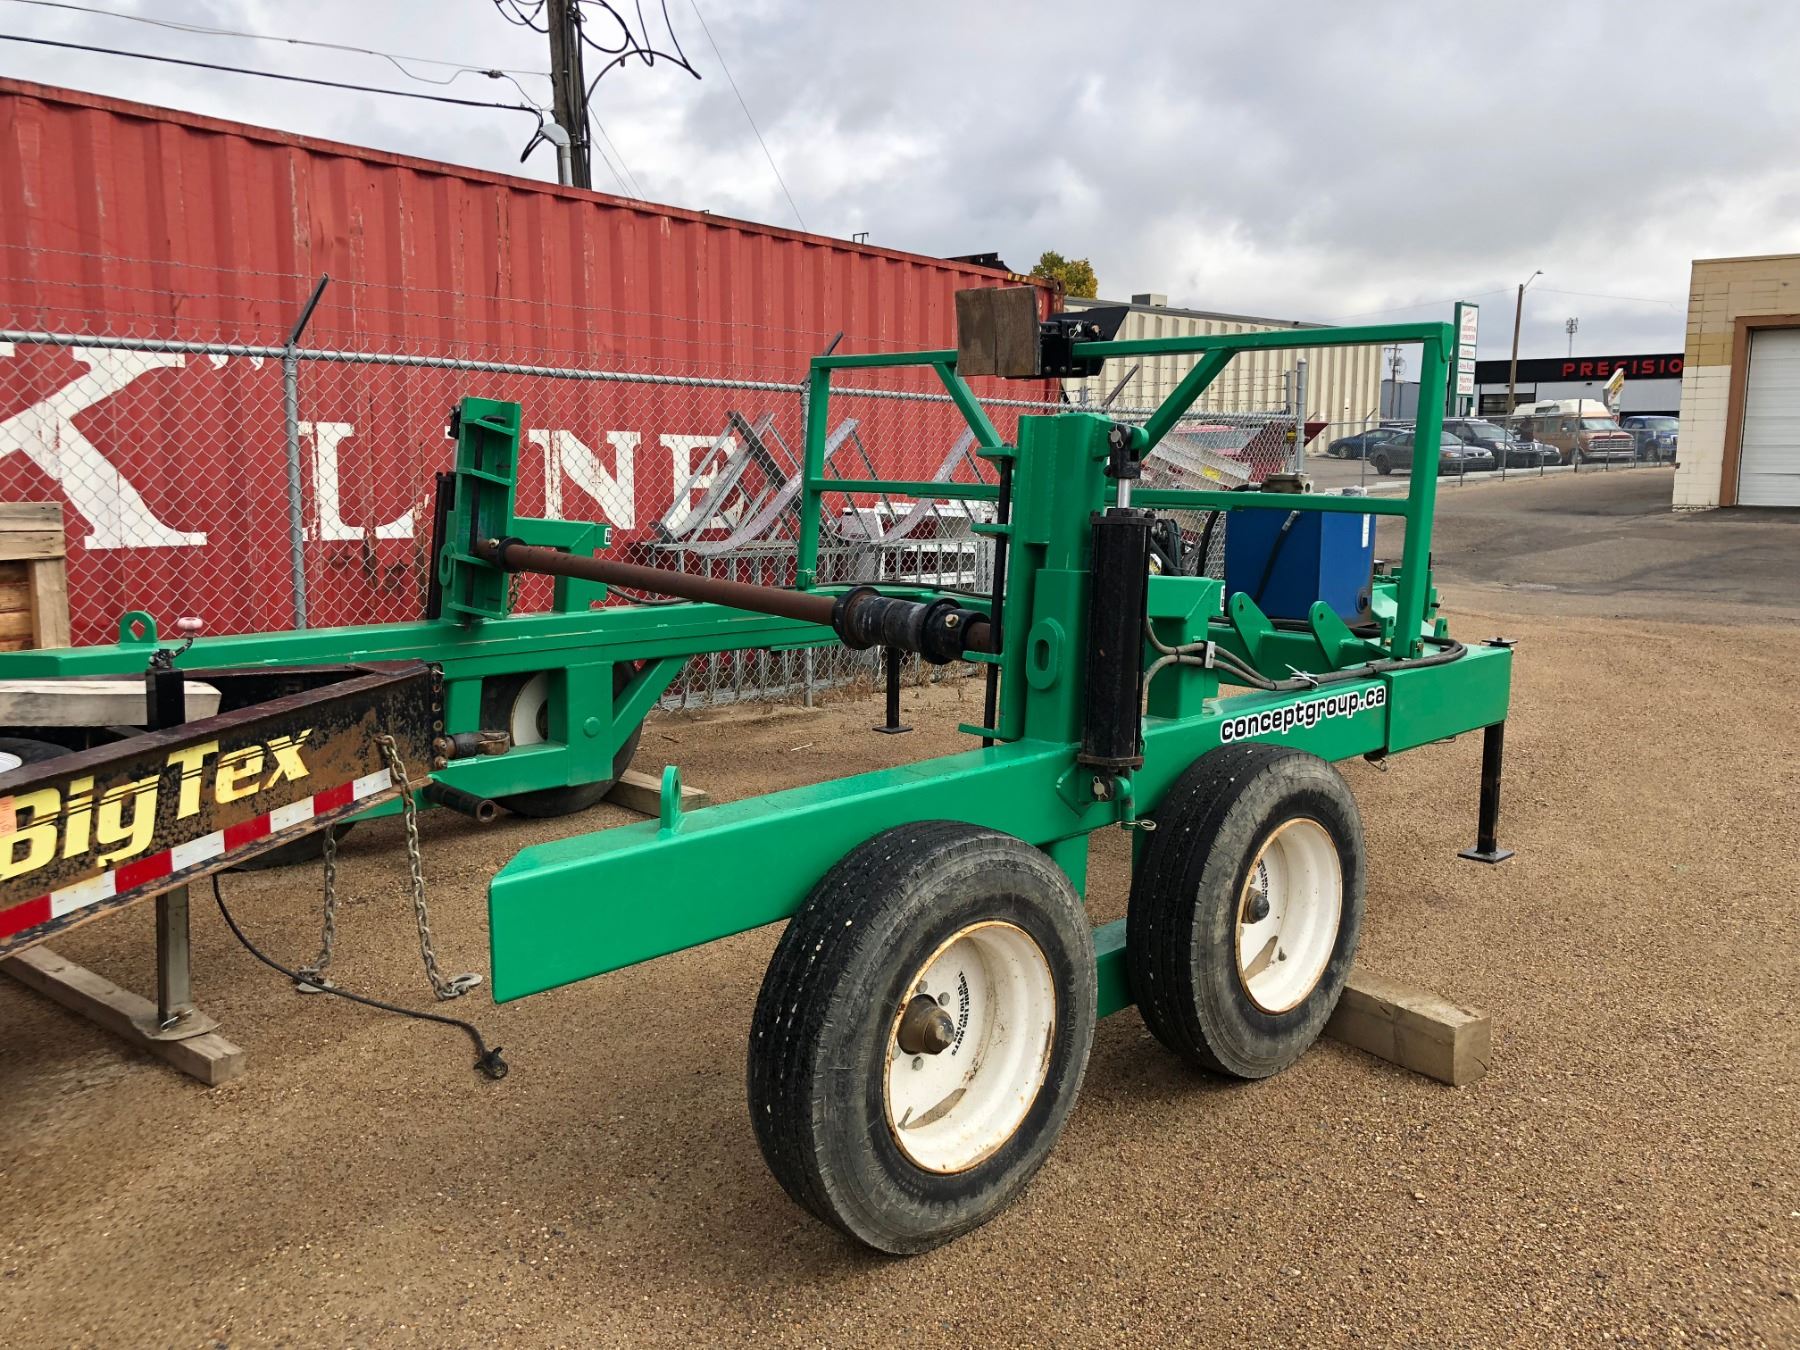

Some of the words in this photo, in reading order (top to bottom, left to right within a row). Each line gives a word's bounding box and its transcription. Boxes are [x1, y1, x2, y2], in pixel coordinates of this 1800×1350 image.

[298, 420, 744, 542] LNE
[1220, 685, 1386, 743] conceptgroup.ca
[958, 970, 970, 1006] TORQUE
[951, 1030, 965, 1056] NUTS
